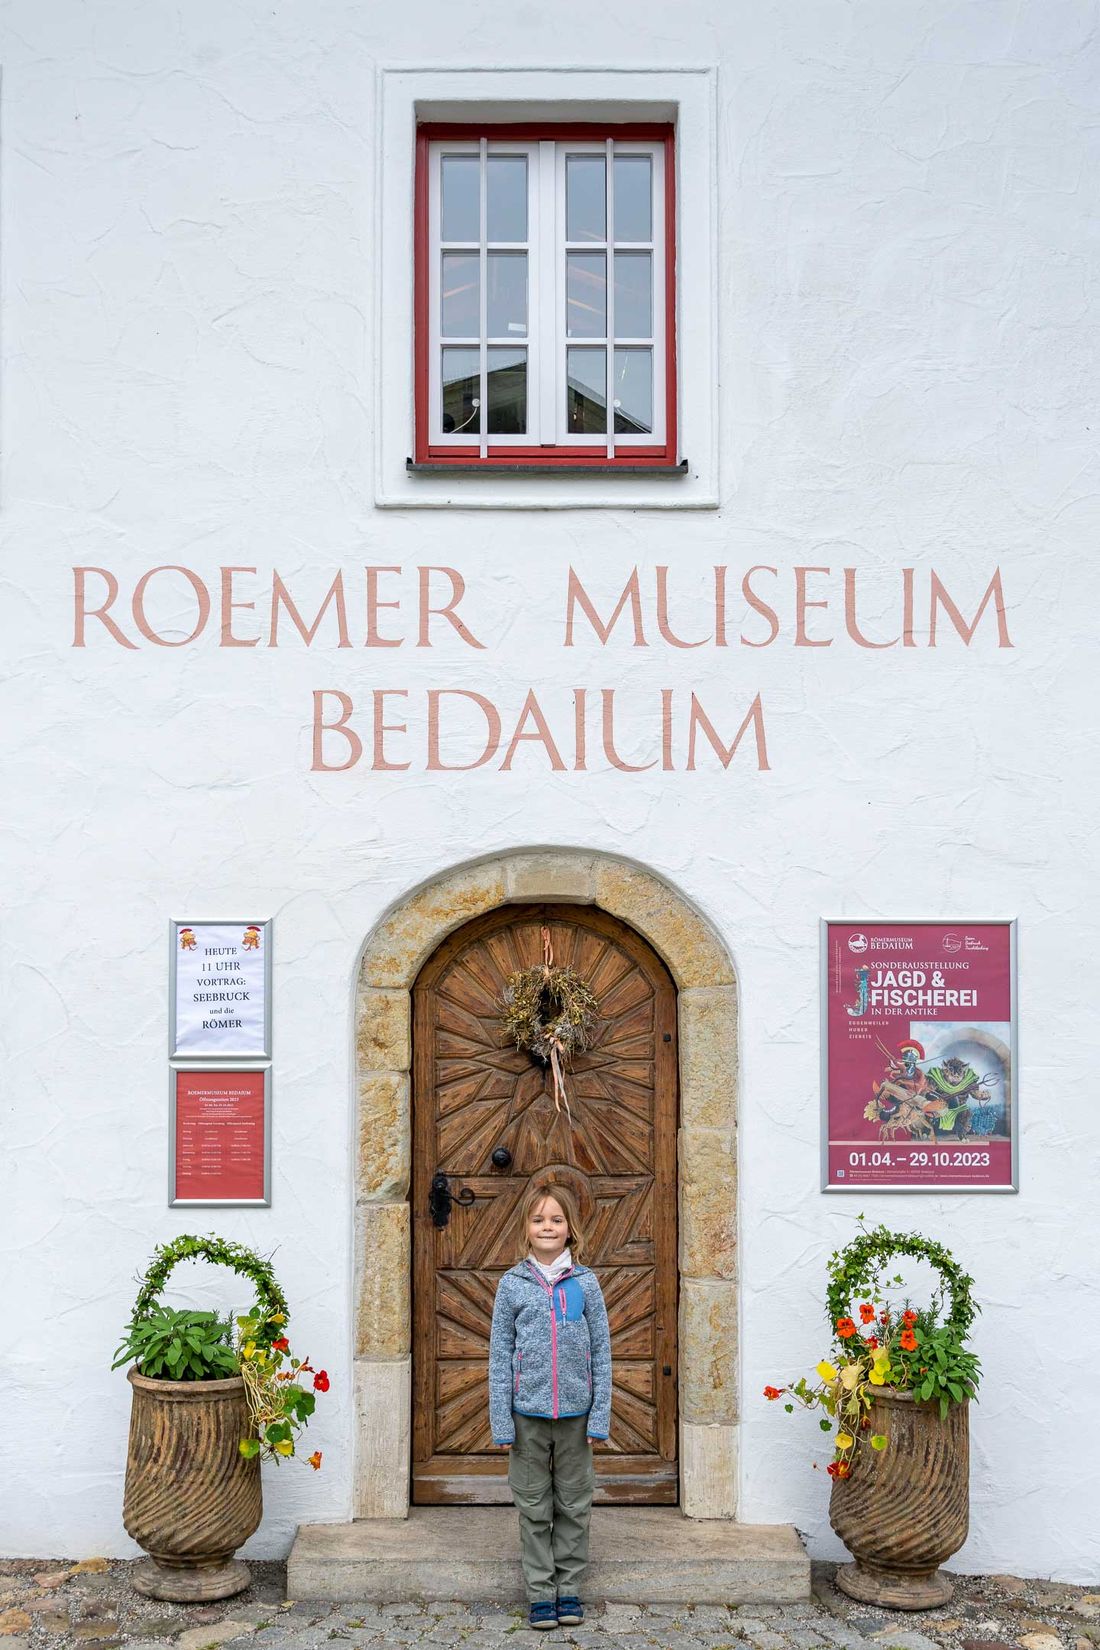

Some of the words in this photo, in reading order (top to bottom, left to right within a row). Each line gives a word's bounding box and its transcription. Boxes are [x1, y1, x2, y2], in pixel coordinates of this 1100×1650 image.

[72, 565, 487, 649] ROEMER
[563, 565, 1014, 649] MUSEUM
[310, 688, 771, 772] BEDAIUM
[204, 947, 238, 956] HEUTE
[870, 942, 914, 950] BEDAIUM
[202, 962, 212, 972] 11
[215, 961, 241, 971] UHR
[870, 961, 970, 970] SONDERAUSSTELLUNG
[196, 977, 247, 987] VORTRAG:
[870, 970, 927, 988] JAGD
[931, 970, 946, 988] &
[193, 991, 250, 1003] SEEBRUCK
[870, 989, 978, 1007] FISCHEREI
[209, 1007, 223, 1015] und
[223, 1006, 235, 1014] die
[871, 1008, 882, 1016] IN
[884, 1008, 903, 1016] DER
[904, 1008, 938, 1016] ANTIKE
[202, 1018, 243, 1030] RÖMER
[909, 1152, 991, 1167] 29.10.2023
